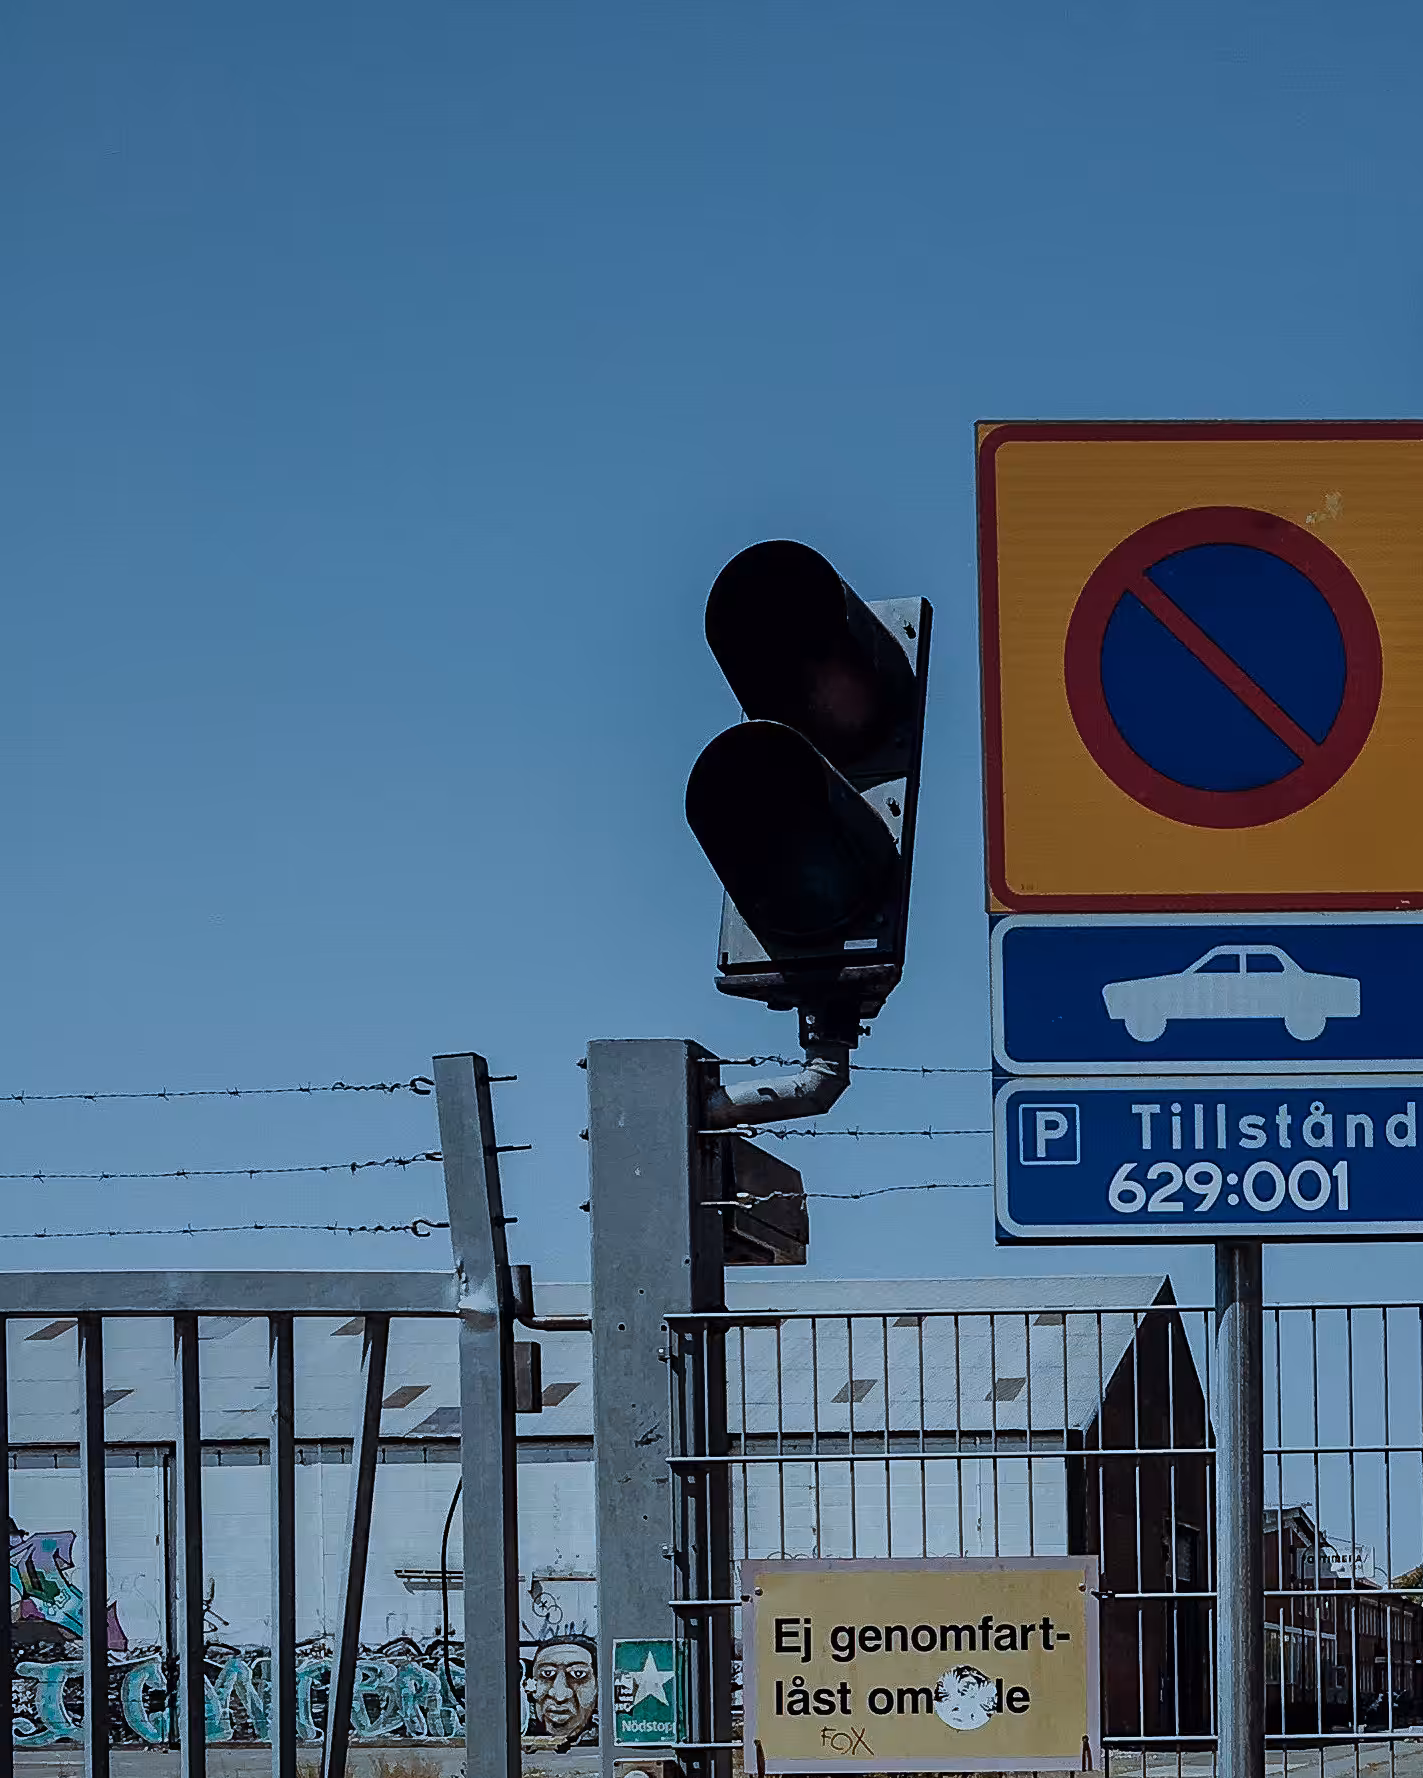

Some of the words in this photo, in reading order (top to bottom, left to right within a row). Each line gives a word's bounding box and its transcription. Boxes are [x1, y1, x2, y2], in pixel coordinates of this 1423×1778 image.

[1036, 1110, 1069, 1158] P
[1131, 1100, 1418, 1150] Tillstånd
[1107, 1160, 1349, 1214] 629:001
[1306, 1554, 1362, 1564] OTIMEA
[773, 1617, 813, 1663] Ej
[829, 1615, 1071, 1663] genomfart-
[775, 1675, 852, 1716] låst
[867, 1677, 1031, 1716] ome
[820, 1725, 875, 1756] FOX
